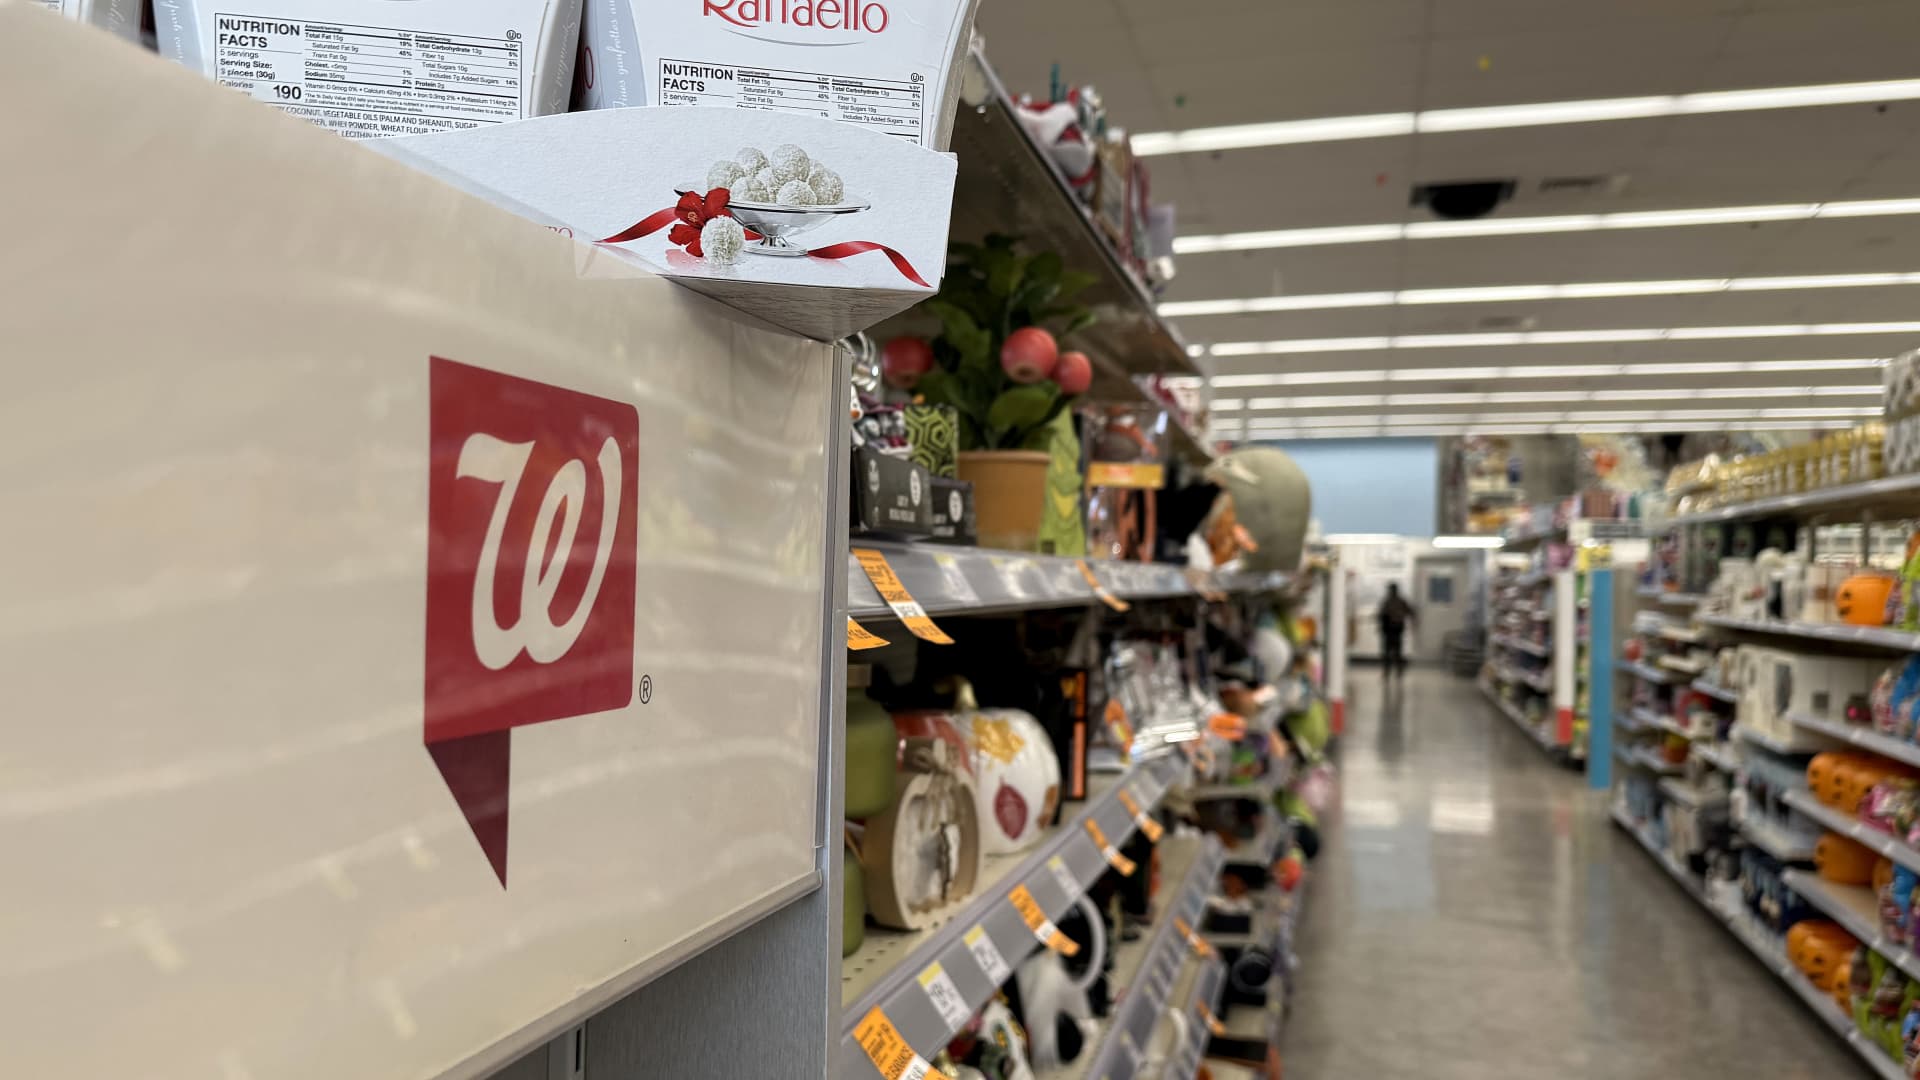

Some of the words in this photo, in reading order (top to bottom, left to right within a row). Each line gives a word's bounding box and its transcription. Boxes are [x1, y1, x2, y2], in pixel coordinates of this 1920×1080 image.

[219, 18, 300, 36] NUTRITION
[219, 33, 268, 48] FACTS
[312, 42, 340, 50] Saturated
[431, 44, 470, 53] Carbohydrate
[227, 51, 259, 60] servings
[220, 58, 251, 69] Serving
[252, 60, 273, 69] Size:
[437, 63, 456, 72] Sugars
[227, 69, 254, 78] pieces
[256, 70, 276, 80] (30g)
[305, 70, 328, 78] Sodium
[663, 63, 734, 81] NUTRITION
[415, 80, 436, 88] Protein
[429, 72, 452, 80] Includes
[461, 75, 479, 83] Added
[480, 77, 499, 85] Sugars
[663, 77, 705, 92] FACTS
[273, 84, 302, 100] 190
[846, 87, 879, 97] Carbohydrate
[669, 94, 698, 103] servings
[850, 104, 867, 113] Sugars
[323, 109, 361, 120] VEGETABLE
[363, 113, 378, 121] OILS
[380, 114, 401, 123] (PALM
[402, 116, 417, 124] AND
[843, 113, 863, 121] Includes
[887, 117, 904, 125] Sugars
[349, 121, 379, 131] POWDER,
[381, 124, 405, 133] WHEAT
[455, 431, 623, 671] W
